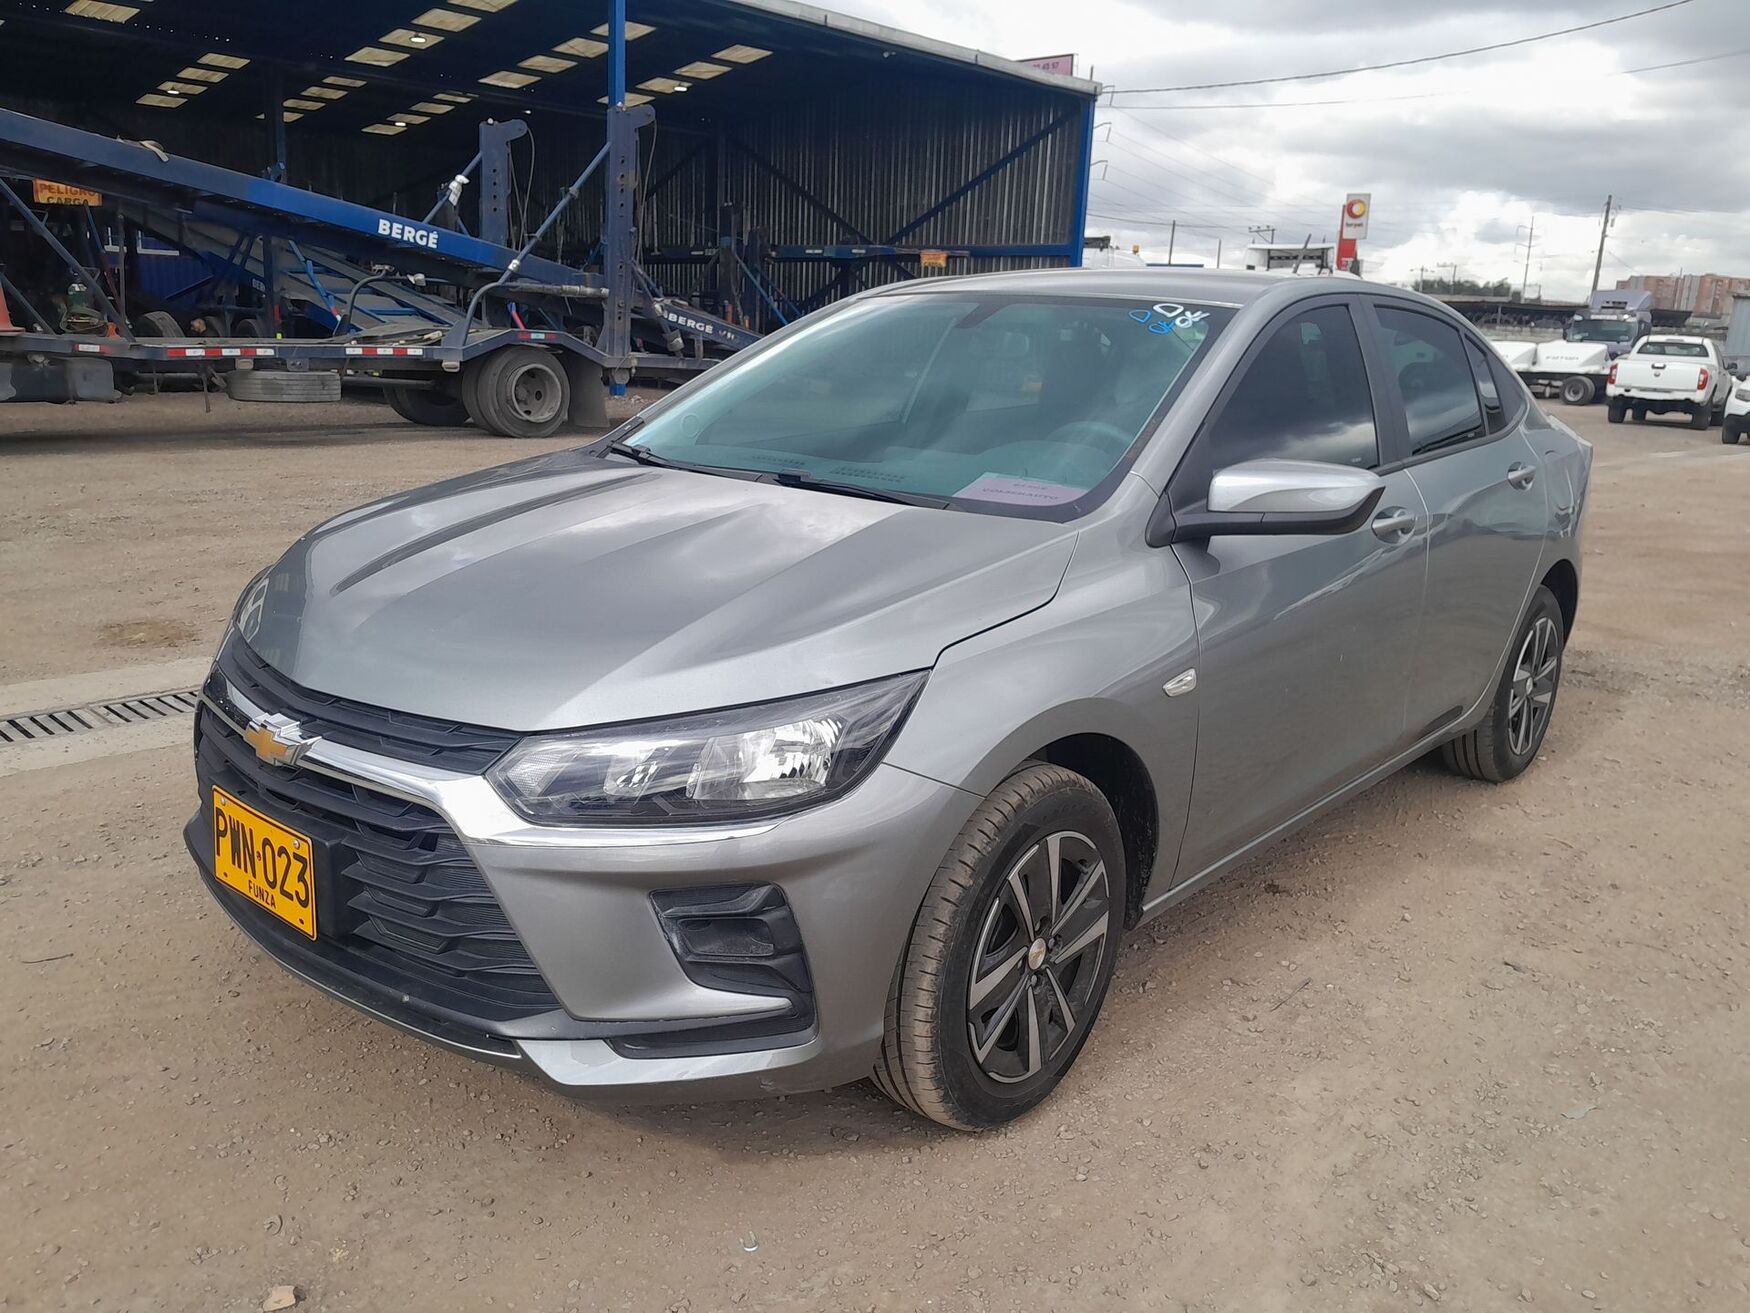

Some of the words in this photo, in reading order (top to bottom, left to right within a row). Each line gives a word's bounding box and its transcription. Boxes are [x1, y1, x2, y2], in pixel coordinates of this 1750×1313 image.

[38, 183, 97, 197] PELIGRO
[46, 196, 89, 205] CARGA
[378, 218, 439, 249] BERGÉ
[248, 879, 277, 909] FUNZA
